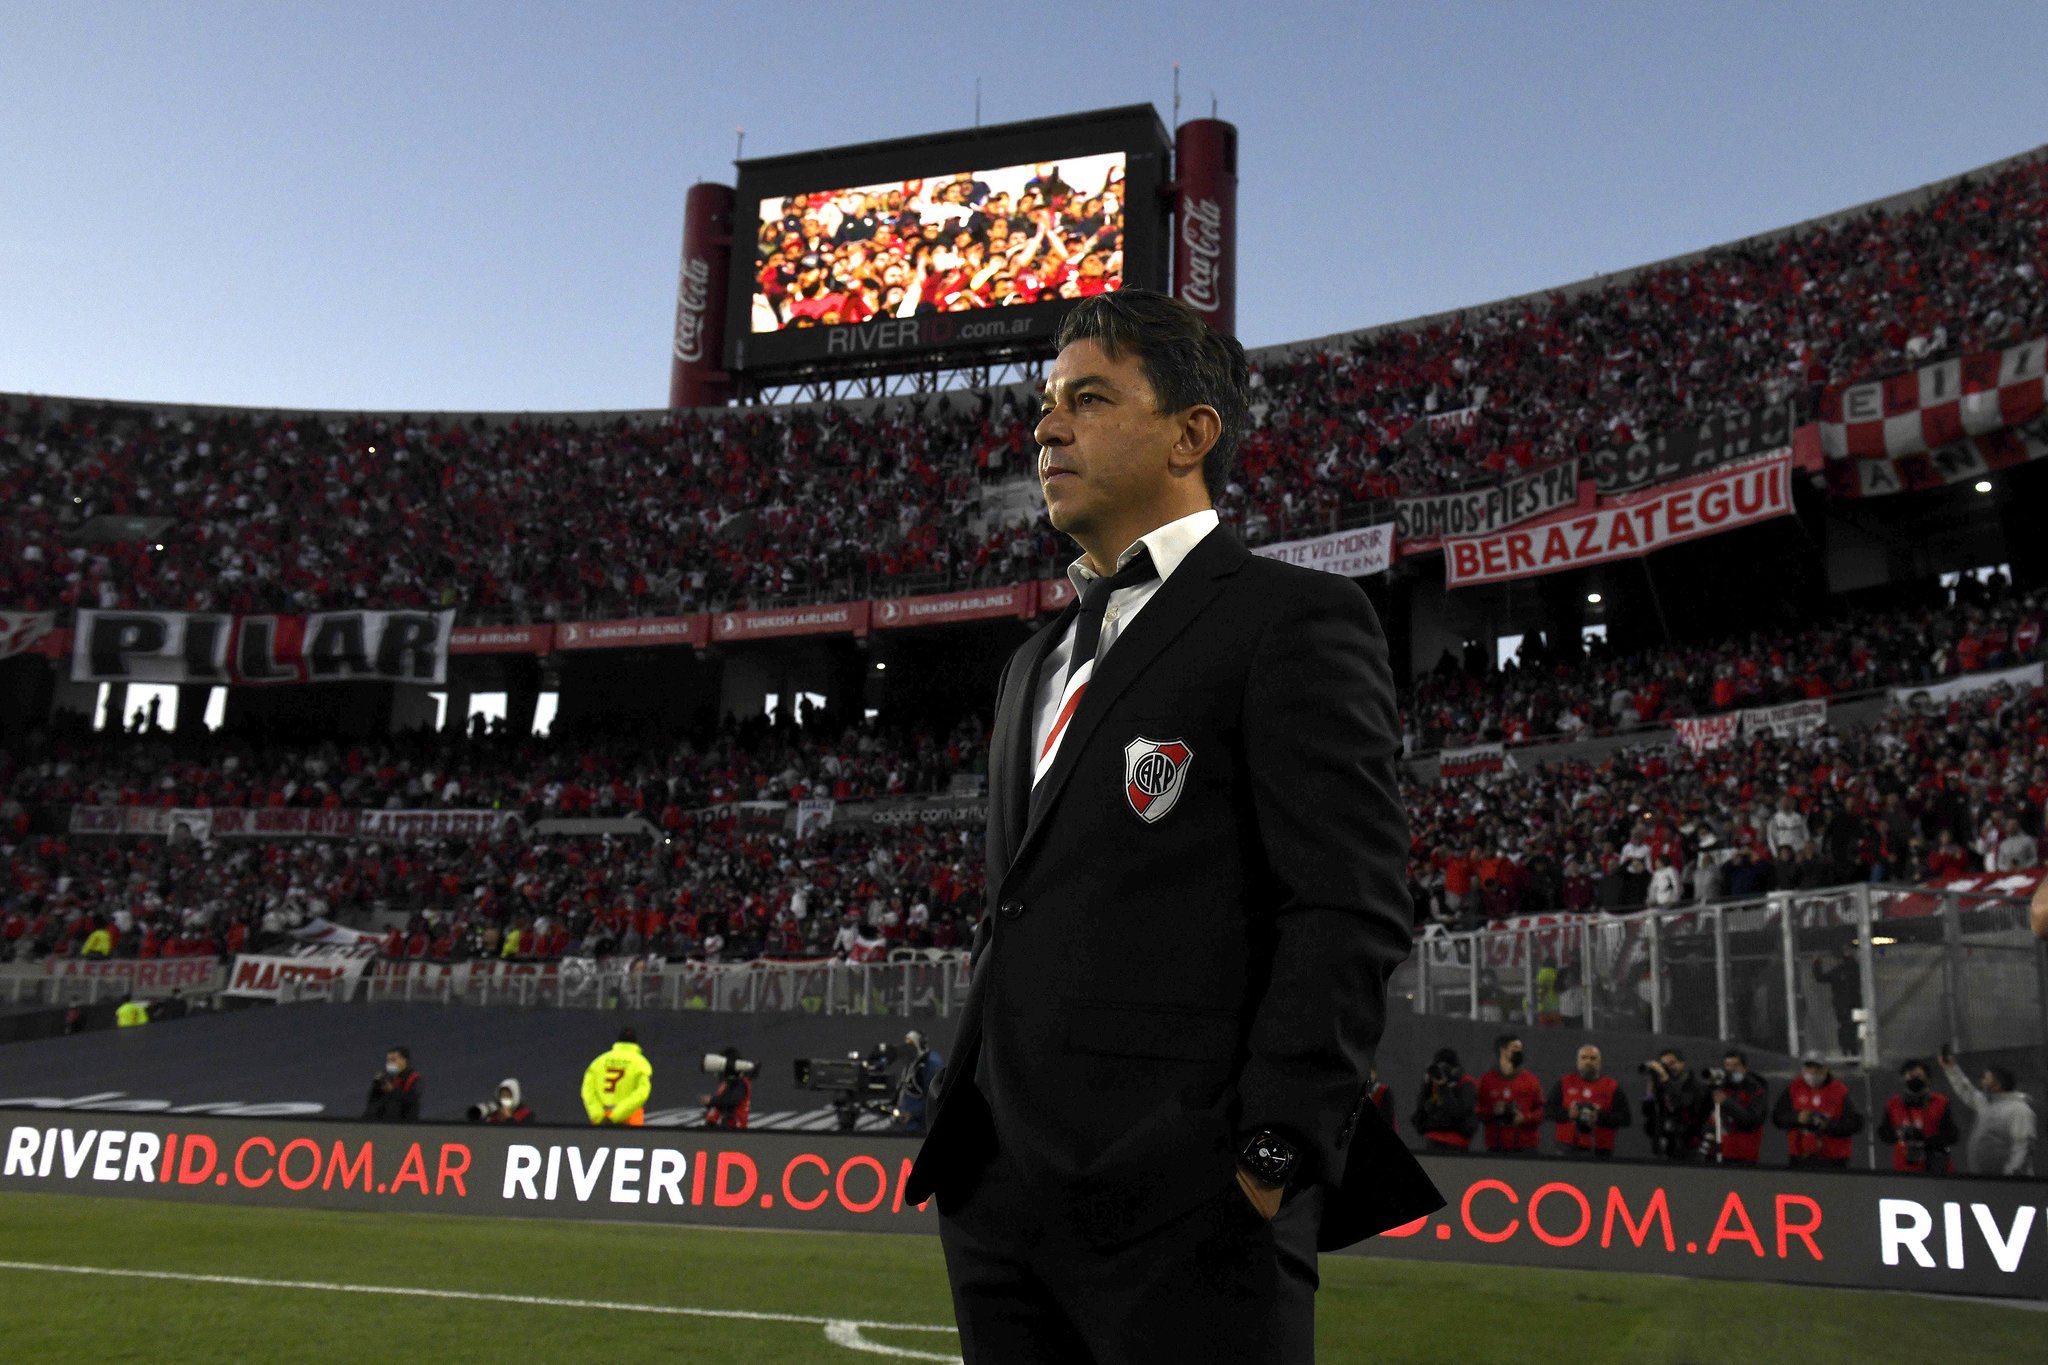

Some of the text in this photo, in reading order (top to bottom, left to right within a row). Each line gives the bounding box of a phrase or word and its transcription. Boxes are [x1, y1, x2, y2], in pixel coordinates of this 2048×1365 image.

[1396, 460, 1575, 538] SOMOS FIESTA
[1455, 465, 1780, 579] BERAZATEGUI
[90, 614, 440, 680] PILAR
[4, 1126, 472, 1197] RIVERID.COM.AR
[1380, 1178, 1825, 1262] .COM.AR
[1879, 1198, 2048, 1273] RIV
